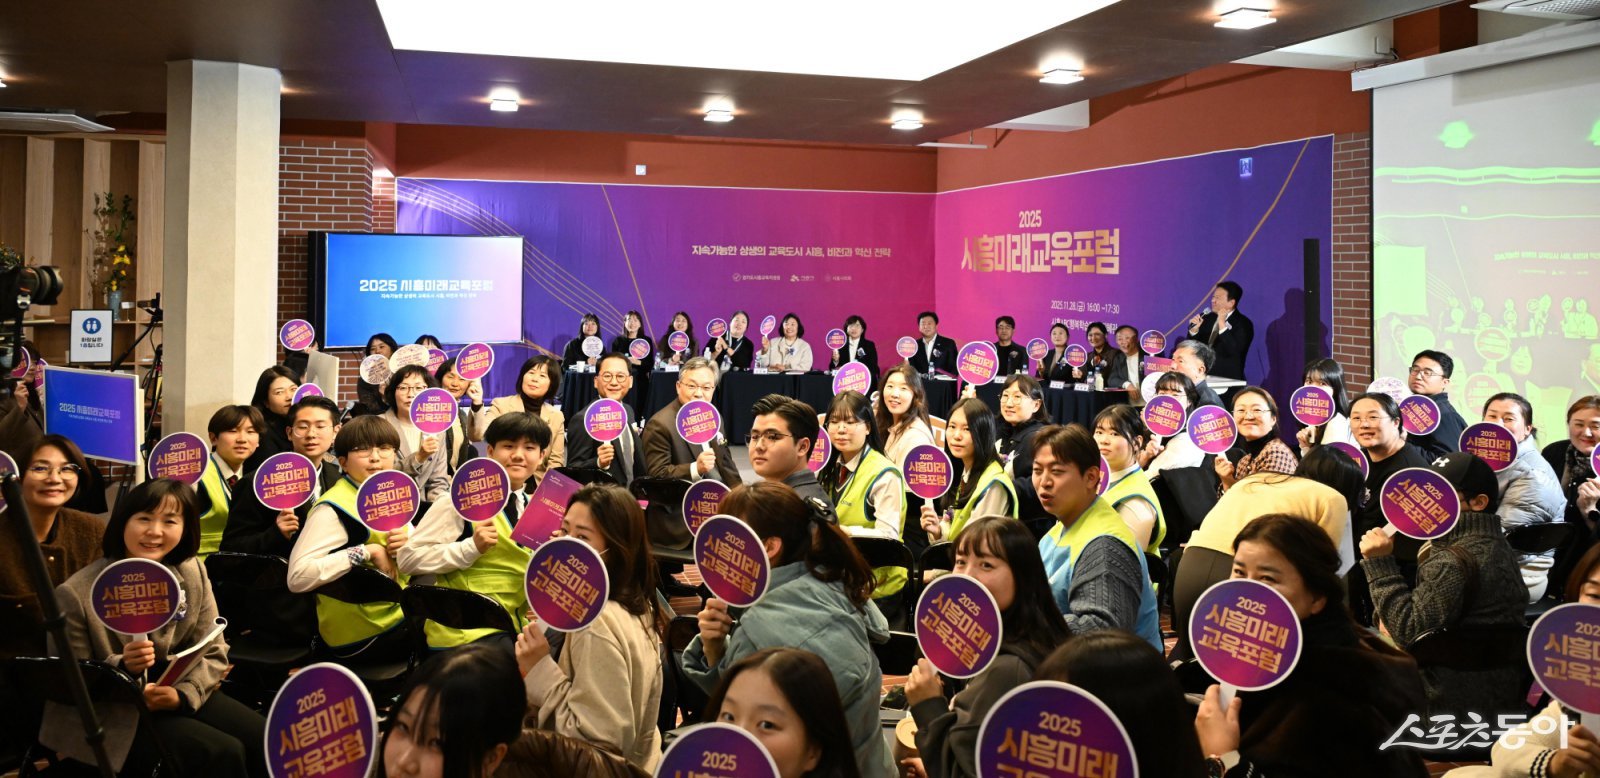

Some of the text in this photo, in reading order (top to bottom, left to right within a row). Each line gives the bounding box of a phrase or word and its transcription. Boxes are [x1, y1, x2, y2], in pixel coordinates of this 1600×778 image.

[1018, 210, 1042, 228] 2025
[692, 245, 737, 256] 지속가능한
[740, 246, 766, 256] 상생의
[768, 246, 803, 257] 교육도시
[827, 248, 852, 257] 비전과
[854, 248, 872, 258] 혁신
[874, 248, 891, 258] 전략
[960, 228, 1120, 274] 시흥미래교육포럼
[360, 280, 493, 292] 2025 시흥미래교육포럼
[460, 351, 489, 365] 시흥미래
[963, 353, 994, 369] 시흥미래
[960, 361, 992, 378] 교육포럼
[59, 402, 76, 413] 2025
[416, 402, 452, 412] 시흥미래
[689, 407, 701, 415] 2025
[1296, 399, 1329, 408] 시흥미래
[1296, 406, 1328, 418] 교육포럼
[415, 412, 452, 423] 교육포럼
[590, 411, 622, 422] 시흥미래
[682, 410, 714, 428] 시흥미래
[1147, 414, 1179, 430] 교육포럼
[1150, 405, 1182, 421] 시흥미래
[1200, 413, 1214, 421] 2025
[590, 421, 622, 432] 교육포럼
[683, 420, 717, 437] 교육포럼
[1193, 416, 1229, 435] 시흥미래
[170, 442, 187, 450] 2025
[1197, 428, 1233, 446] 교육포럼
[1466, 436, 1511, 450] 시흥미래
[156, 447, 202, 466] 시흥미래
[156, 462, 202, 478] 교육포럼
[276, 462, 293, 470] 2025
[468, 468, 486, 478] 2025
[908, 461, 946, 473] 시흥미래
[262, 467, 309, 485] 시흥미래
[457, 473, 501, 496] 시흥미래
[909, 473, 947, 487] 교육포럼
[263, 480, 310, 499] 교육포럼
[376, 481, 395, 490] 2025
[1423, 482, 1444, 500] 2025
[363, 486, 412, 507] 시흥미래
[459, 488, 504, 510] 교육포럼
[702, 492, 719, 500] 2025
[1398, 478, 1451, 524] 시흥미래
[365, 500, 414, 522] 교육포럼
[1386, 487, 1438, 535] 교육포럼
[724, 531, 746, 550] 2025
[567, 554, 589, 575] 2025
[704, 534, 761, 579] 시흥미래
[121, 573, 146, 583] 2025
[540, 555, 600, 606] 시흥미래
[700, 550, 757, 597] 교육포럼
[102, 581, 168, 601] 시흥미래
[530, 571, 589, 624] 교육포럼
[103, 599, 170, 619] 교육포럼
[958, 593, 982, 617] 2025
[1236, 596, 1267, 616] 2025
[931, 592, 992, 652] 시흥미래
[1205, 604, 1290, 649] 시흥미래
[1575, 622, 1600, 637] 202
[920, 608, 980, 670] 교육포럼
[1198, 625, 1282, 674] 교육포럼
[296, 688, 327, 714] 2025
[280, 696, 359, 756] 시흥미래
[1038, 711, 1082, 737] 2025
[701, 751, 737, 771] 2025
[997, 727, 1119, 778] 시흥미래
